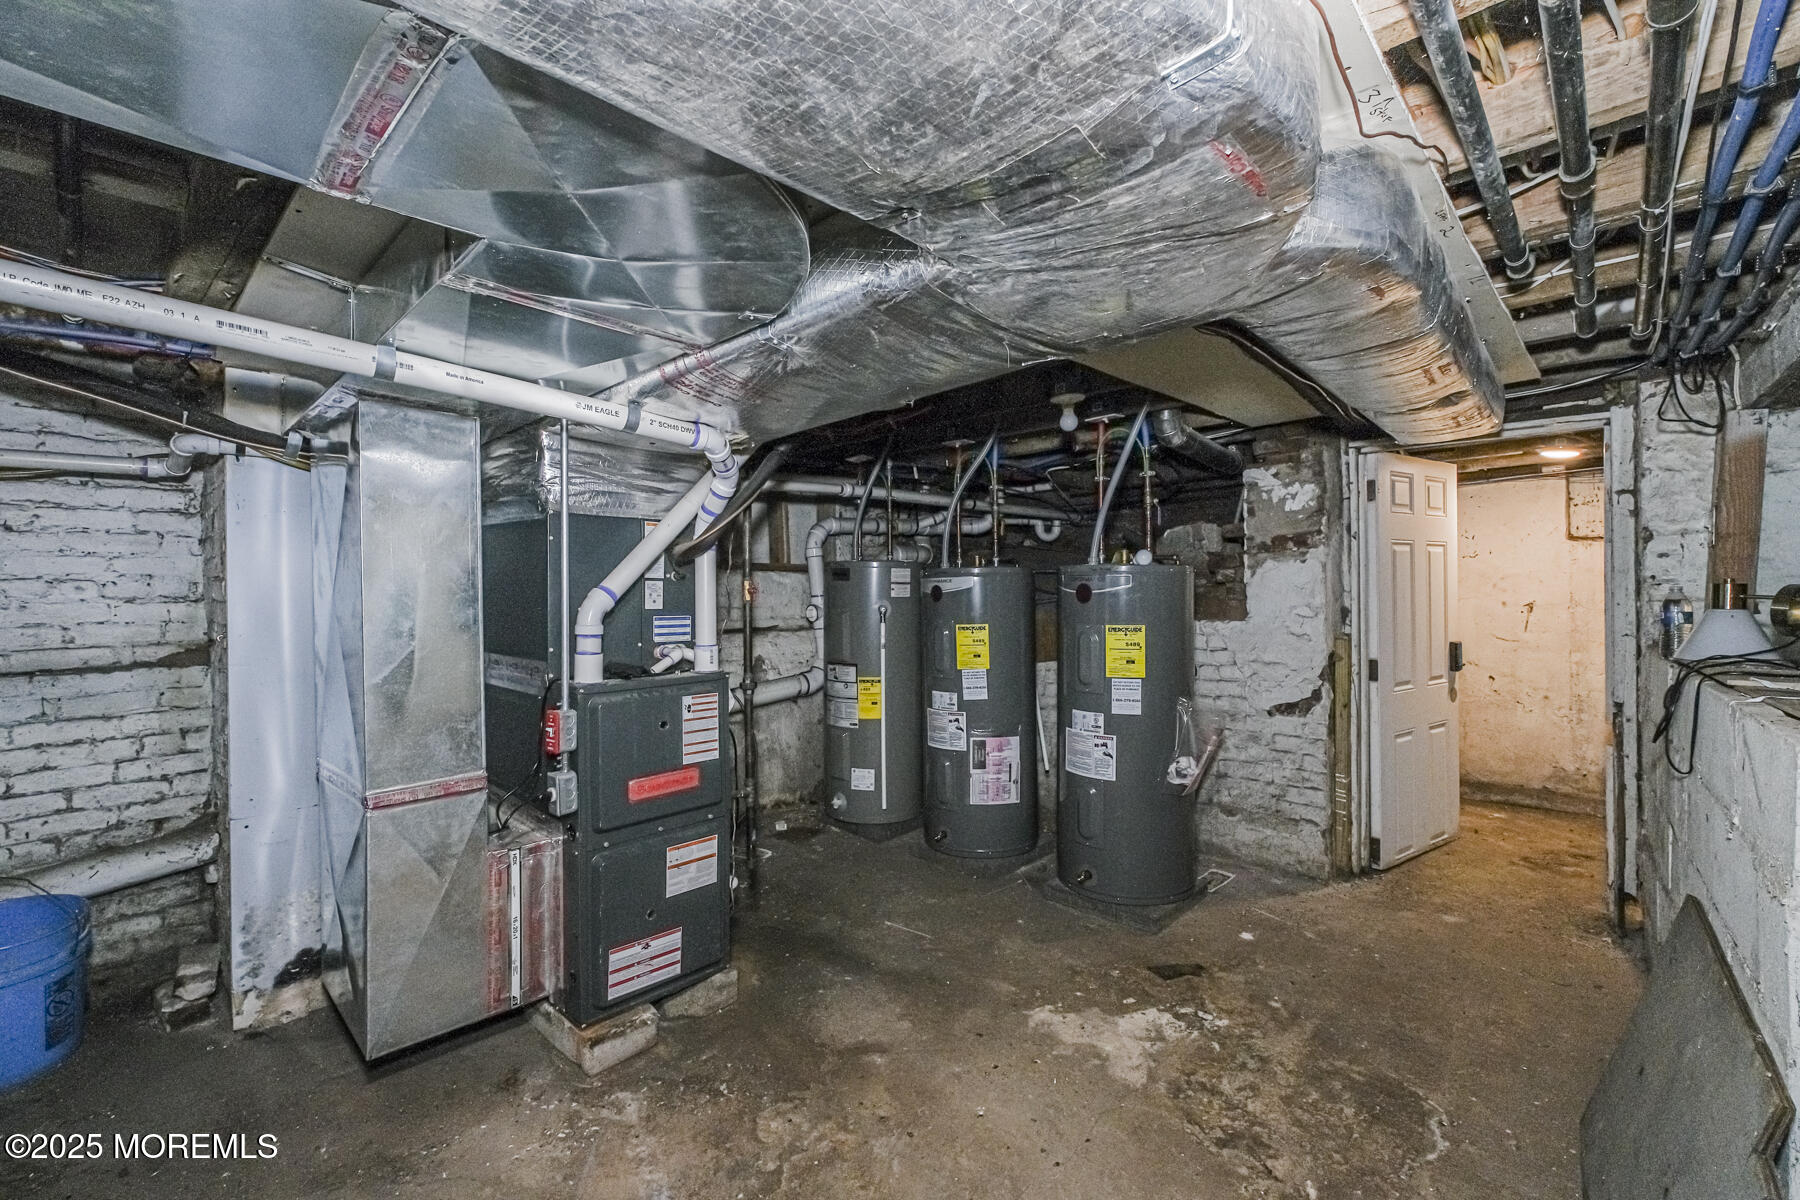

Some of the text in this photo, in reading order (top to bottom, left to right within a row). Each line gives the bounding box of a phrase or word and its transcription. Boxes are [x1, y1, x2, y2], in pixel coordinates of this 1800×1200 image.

[582, 403, 620, 418] JM EAGLE
[658, 421, 680, 432] SCH40
[680, 426, 696, 436] DWV
